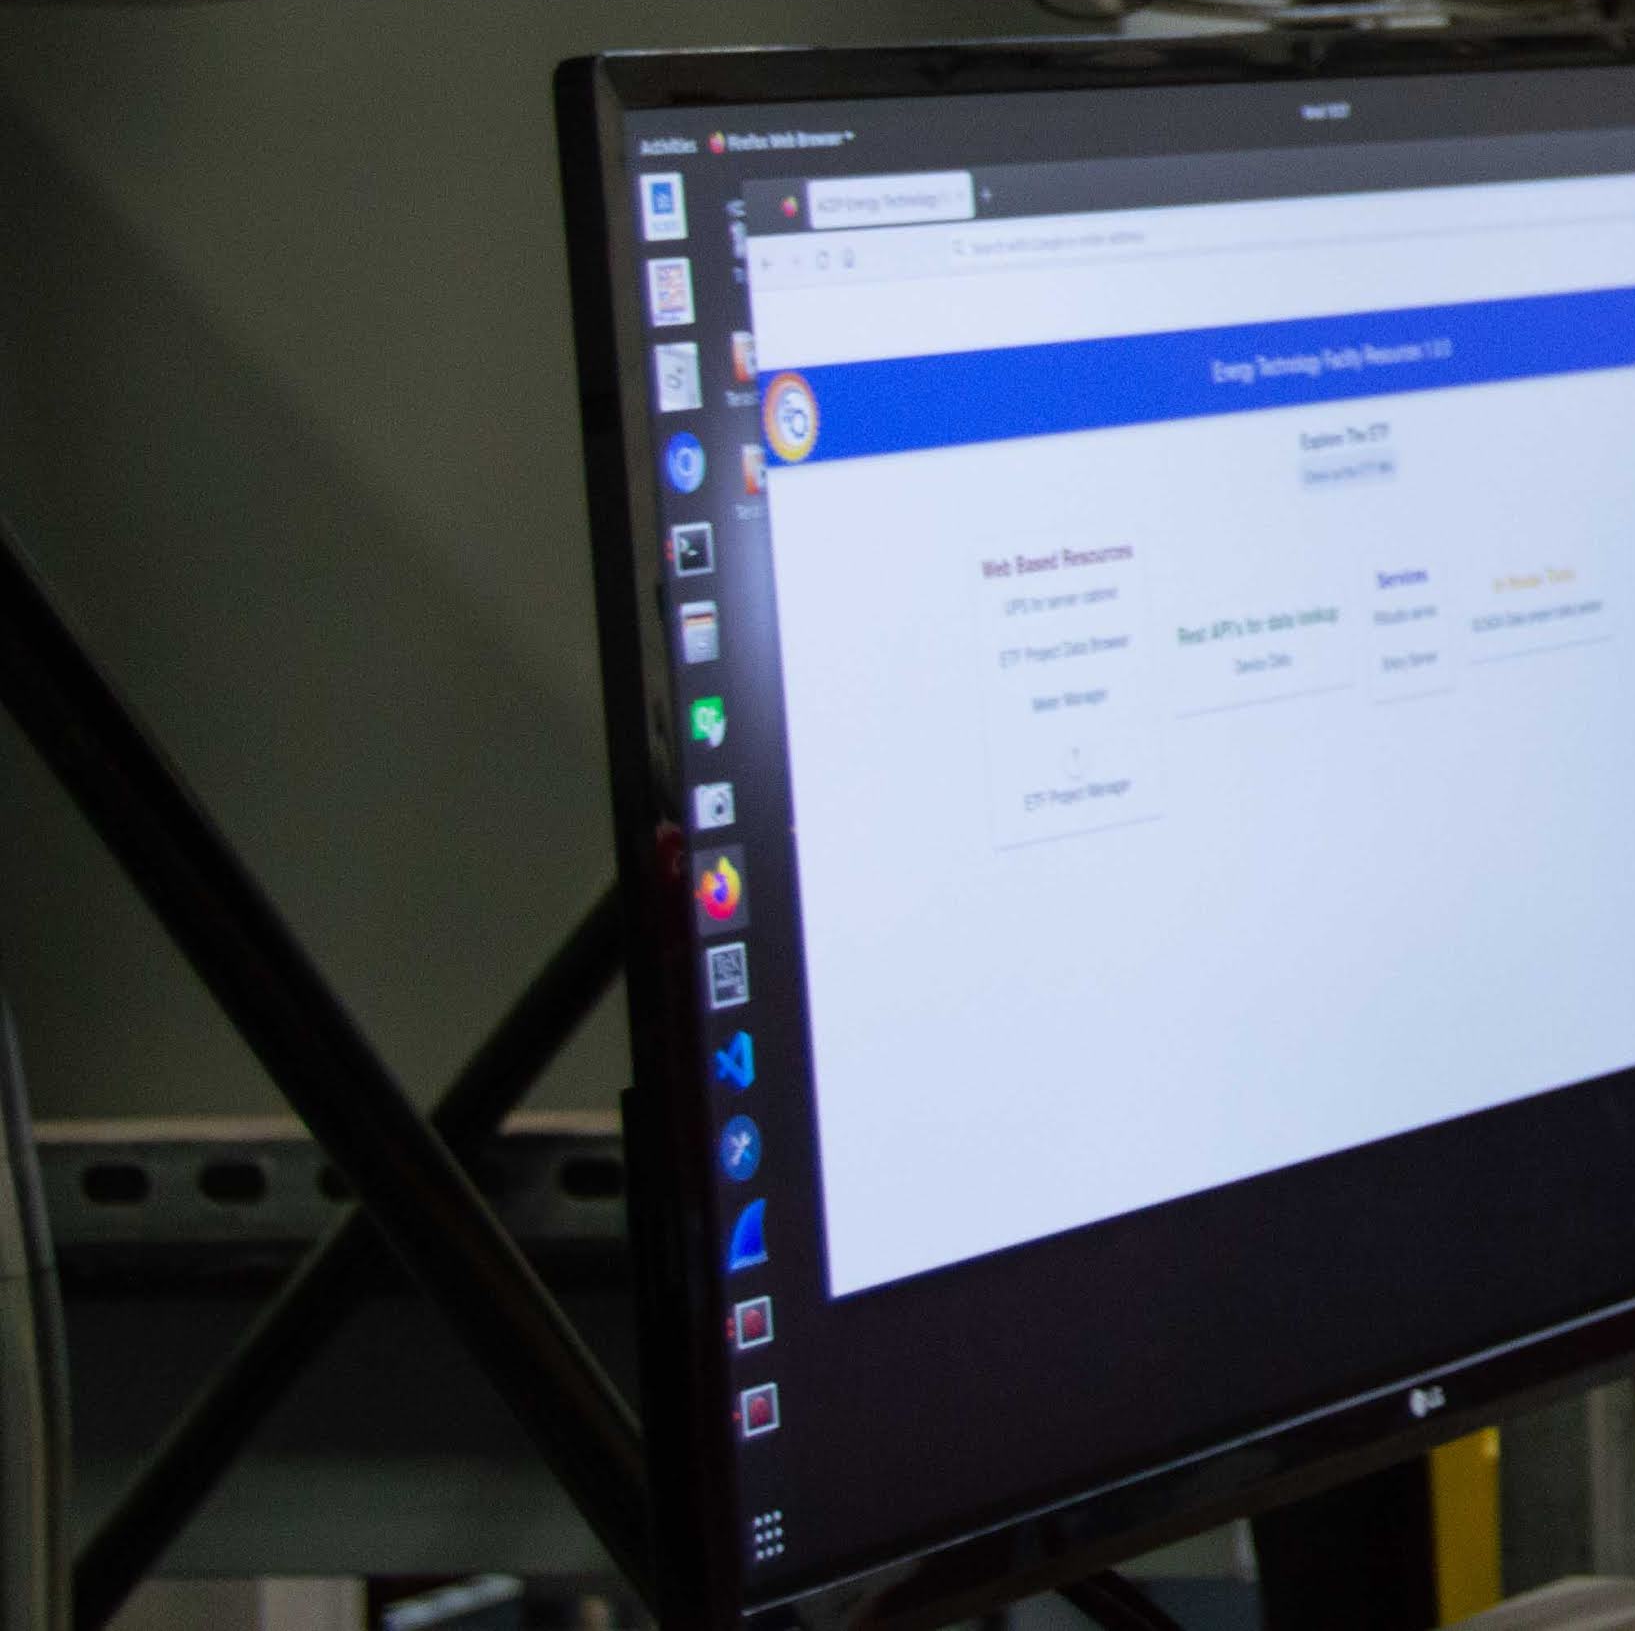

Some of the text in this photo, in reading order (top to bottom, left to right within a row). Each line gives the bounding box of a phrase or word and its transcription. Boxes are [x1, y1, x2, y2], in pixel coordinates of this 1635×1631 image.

[1212, 359, 1254, 384] Energy
[1256, 354, 1322, 377] Technology
[1364, 342, 1423, 365] Resources
[982, 545, 1134, 579] Web Based Resources
[1376, 568, 1429, 589] Services
[1177, 626, 1207, 646] Rest
[1268, 612, 1295, 631] data
